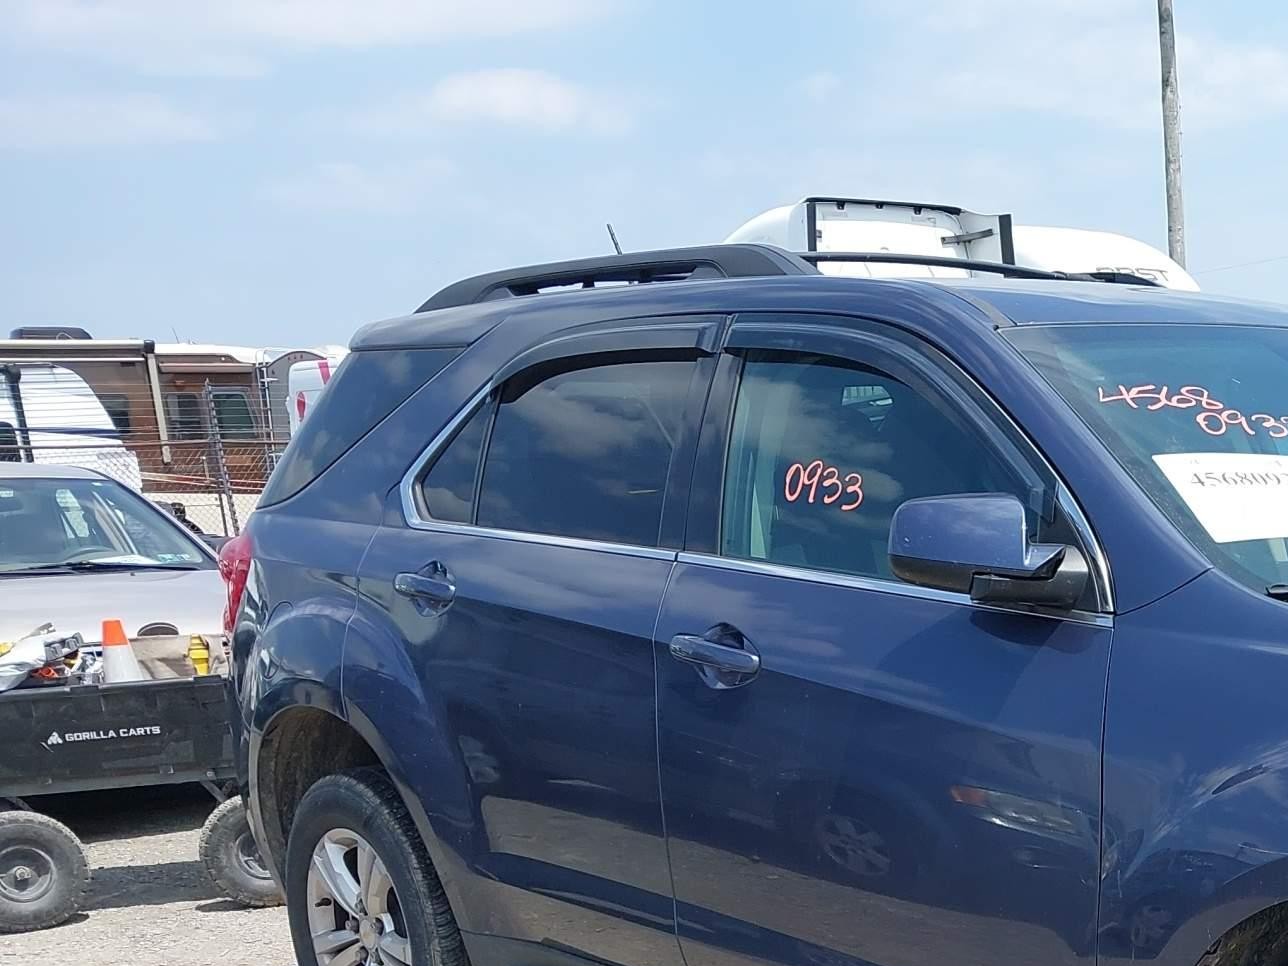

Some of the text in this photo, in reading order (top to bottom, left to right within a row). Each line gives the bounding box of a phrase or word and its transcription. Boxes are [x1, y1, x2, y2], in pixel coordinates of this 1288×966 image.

[1097, 384, 1224, 410] 4568
[784, 460, 864, 511] 0933
[65, 726, 161, 742] GORILLA CARTS
